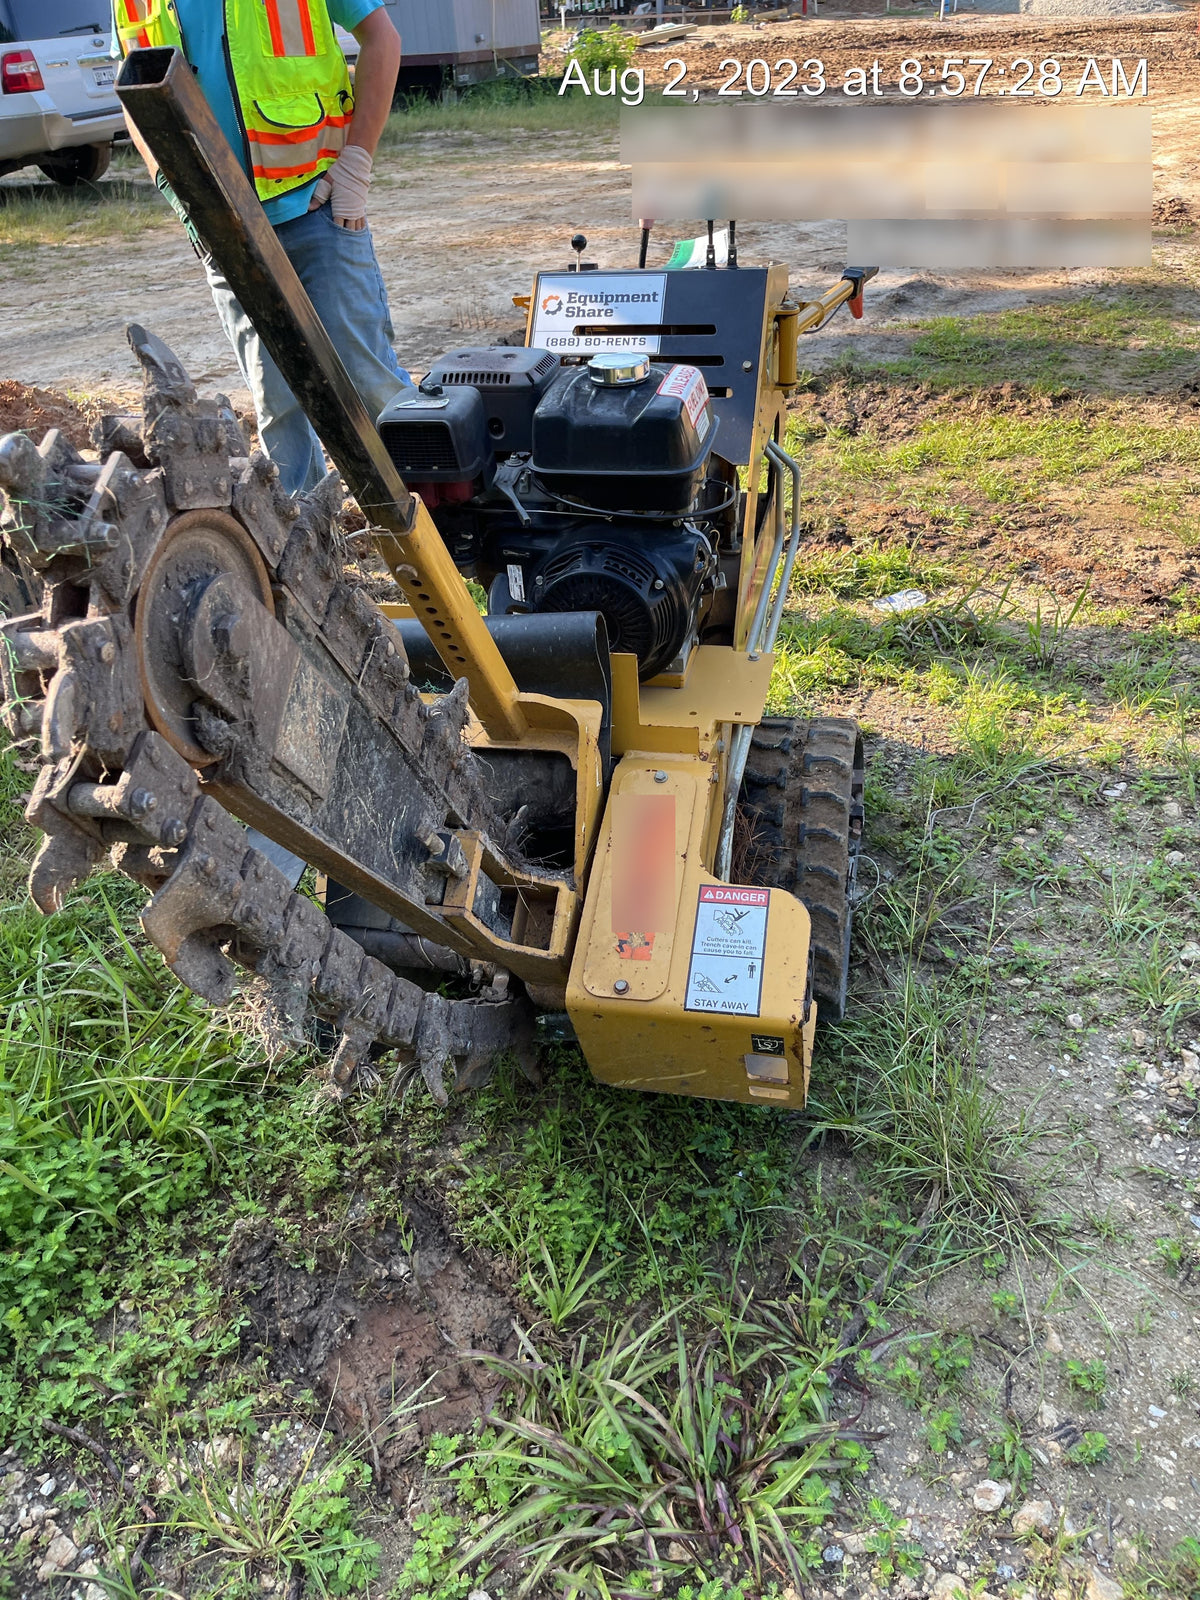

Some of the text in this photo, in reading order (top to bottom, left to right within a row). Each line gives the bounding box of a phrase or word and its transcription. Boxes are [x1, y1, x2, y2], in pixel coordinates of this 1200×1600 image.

[567, 291, 659, 307] Equipment
[565, 305, 614, 318] Share
[546, 336, 647, 347] (888) 80-RENTS
[667, 367, 696, 395] UNLEADED
[716, 891, 766, 903] DANGER
[694, 998, 749, 1010] STAY AWAY
